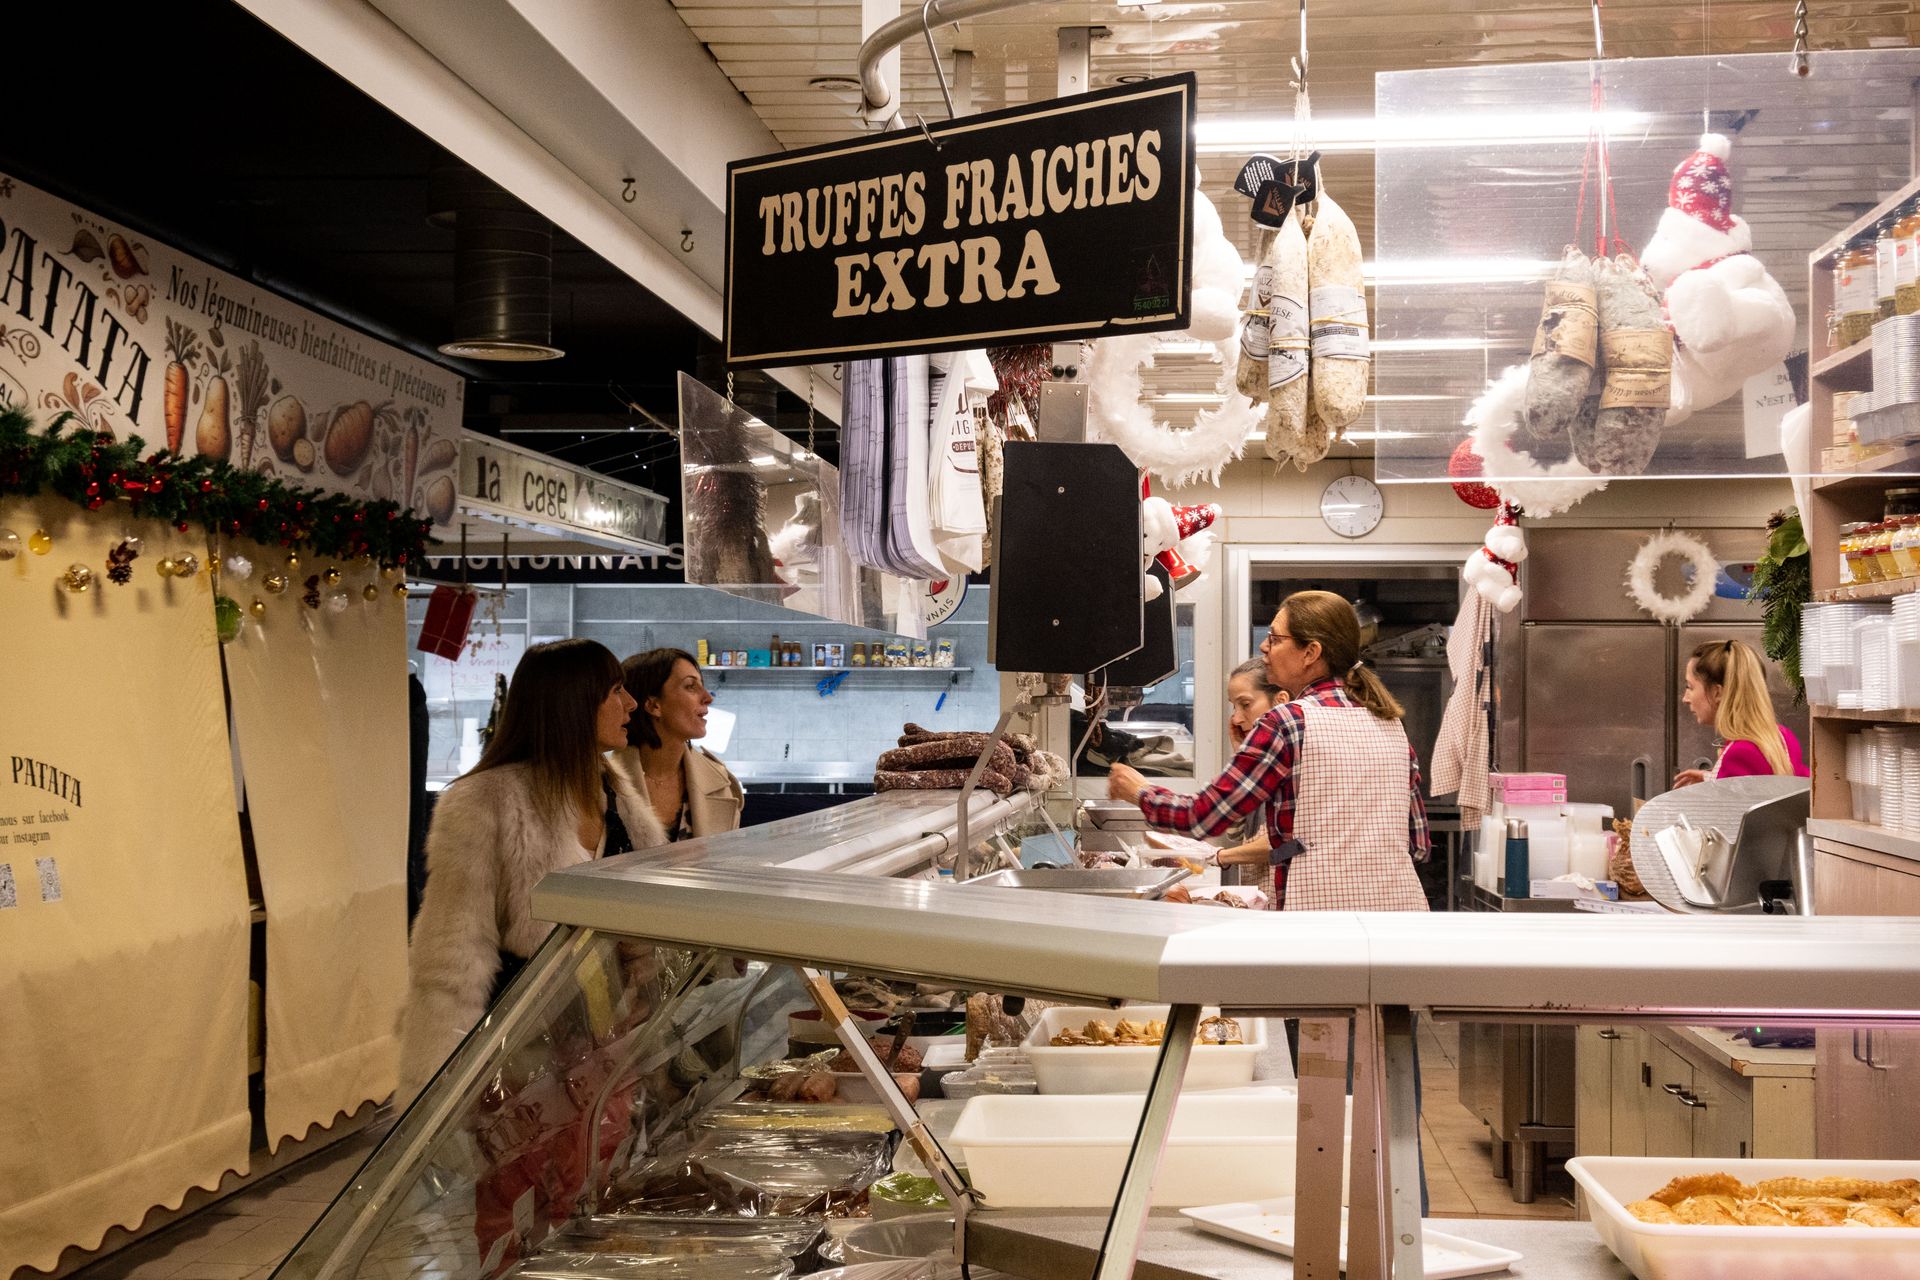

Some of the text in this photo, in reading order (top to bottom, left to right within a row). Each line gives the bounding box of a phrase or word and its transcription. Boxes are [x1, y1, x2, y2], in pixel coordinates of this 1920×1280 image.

[759, 170, 926, 255] TRUFFES
[942, 129, 1162, 230] FRAICHES
[832, 229, 1061, 318] EXTRA
[0, 217, 151, 426] ATATA
[166, 265, 447, 408] Nos légumineuses bienfaitrices et précieuses
[0, 383, 13, 409] AL
[475, 456, 501, 502] la
[523, 472, 568, 519] cage
[11, 755, 82, 808] PATATA
[13, 832, 51, 846] instagram
[22, 815, 35, 824] sur
[39, 809, 70, 824] facebook
